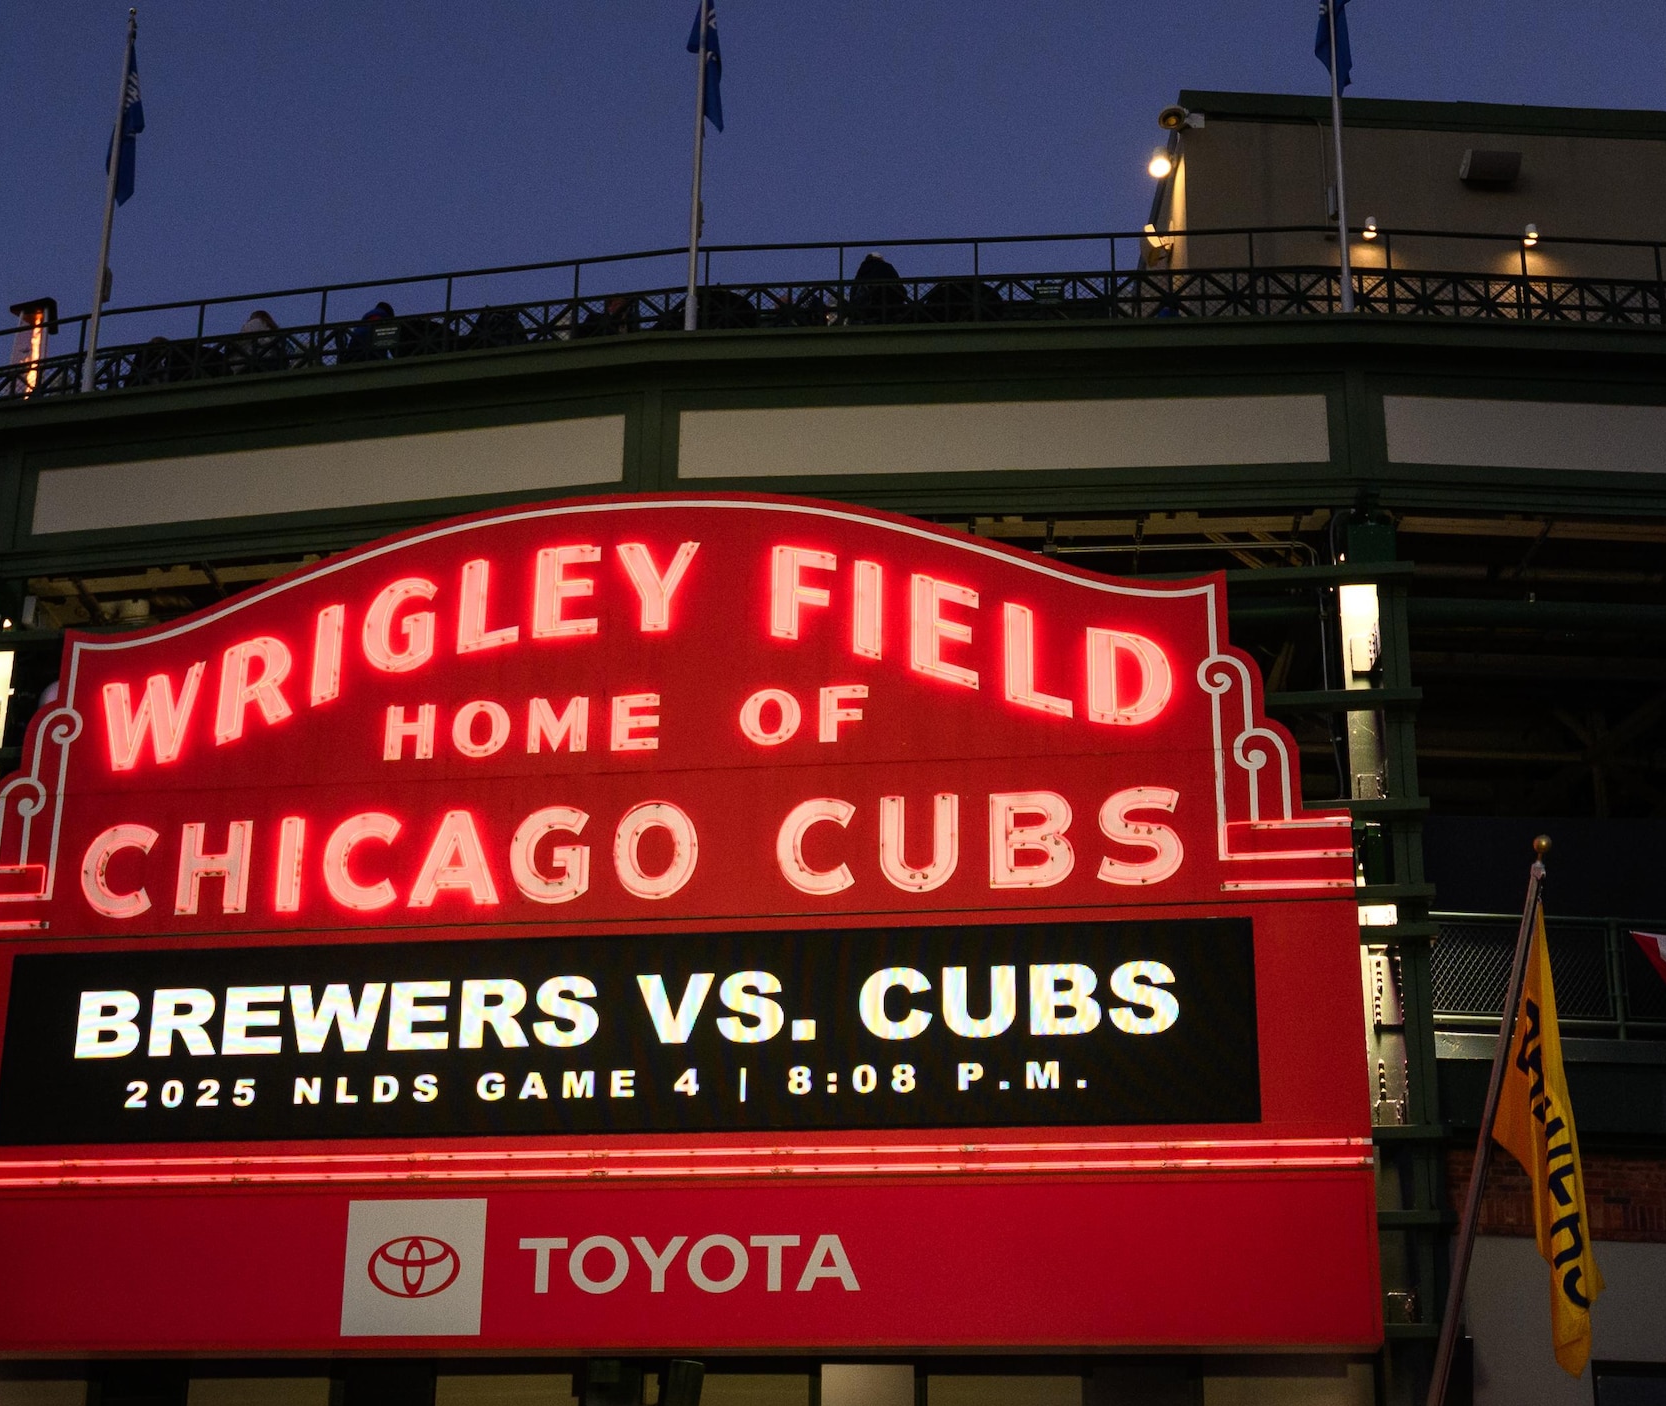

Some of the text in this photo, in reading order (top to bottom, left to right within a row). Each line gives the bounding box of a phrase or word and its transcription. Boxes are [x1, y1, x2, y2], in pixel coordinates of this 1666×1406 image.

[102, 541, 1173, 771] WRIGLEY FIELD
[383, 685, 869, 760] HOME OF
[81, 786, 1184, 919] CHICAGO CUBS
[74, 960, 1180, 1059] BREWERS VS. CUBS
[124, 1078, 256, 1109] 2025
[293, 1074, 439, 1104] NLDS
[476, 1069, 636, 1101] GAME
[673, 1068, 700, 1097] 4
[787, 1064, 917, 1095] 8:08
[957, 1061, 1088, 1091] P.M.
[519, 1234, 861, 1294] TOYOTA
